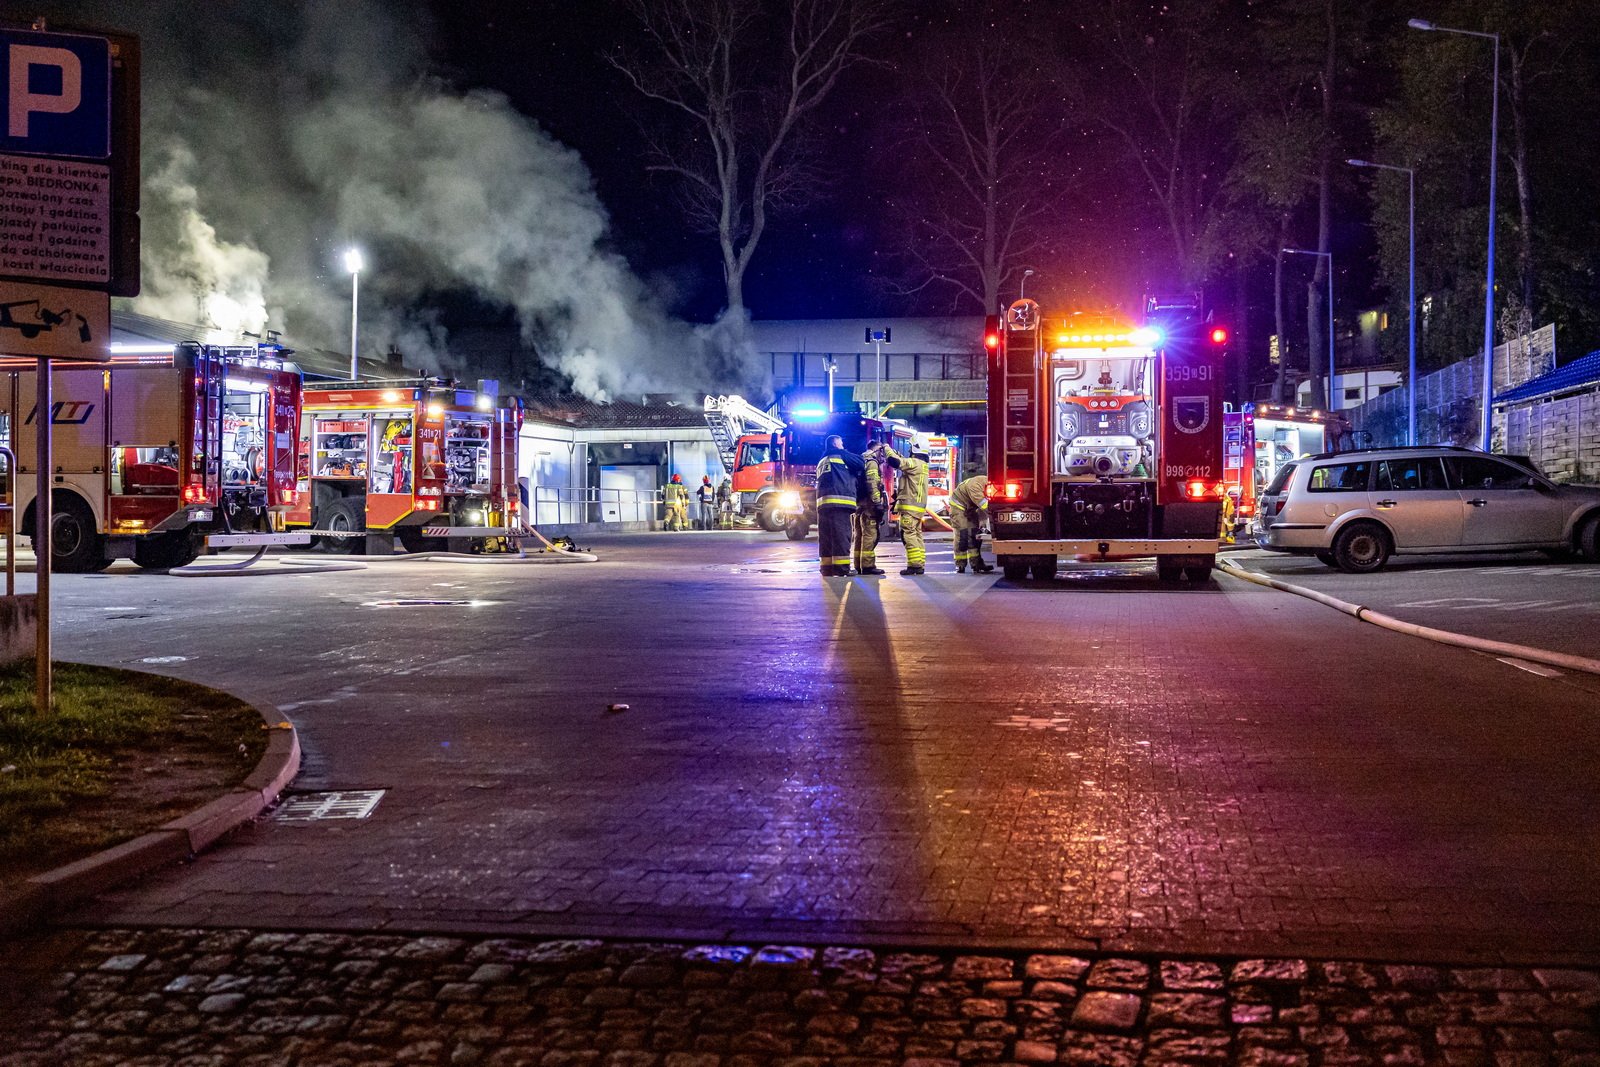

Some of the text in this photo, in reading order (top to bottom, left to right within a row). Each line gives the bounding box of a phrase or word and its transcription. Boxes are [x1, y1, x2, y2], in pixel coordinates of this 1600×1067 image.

[9, 44, 81, 137] P
[33, 164, 52, 174] dla
[69, 196, 94, 206] czas
[3, 259, 34, 270] koszt
[1195, 465, 1211, 477] 112
